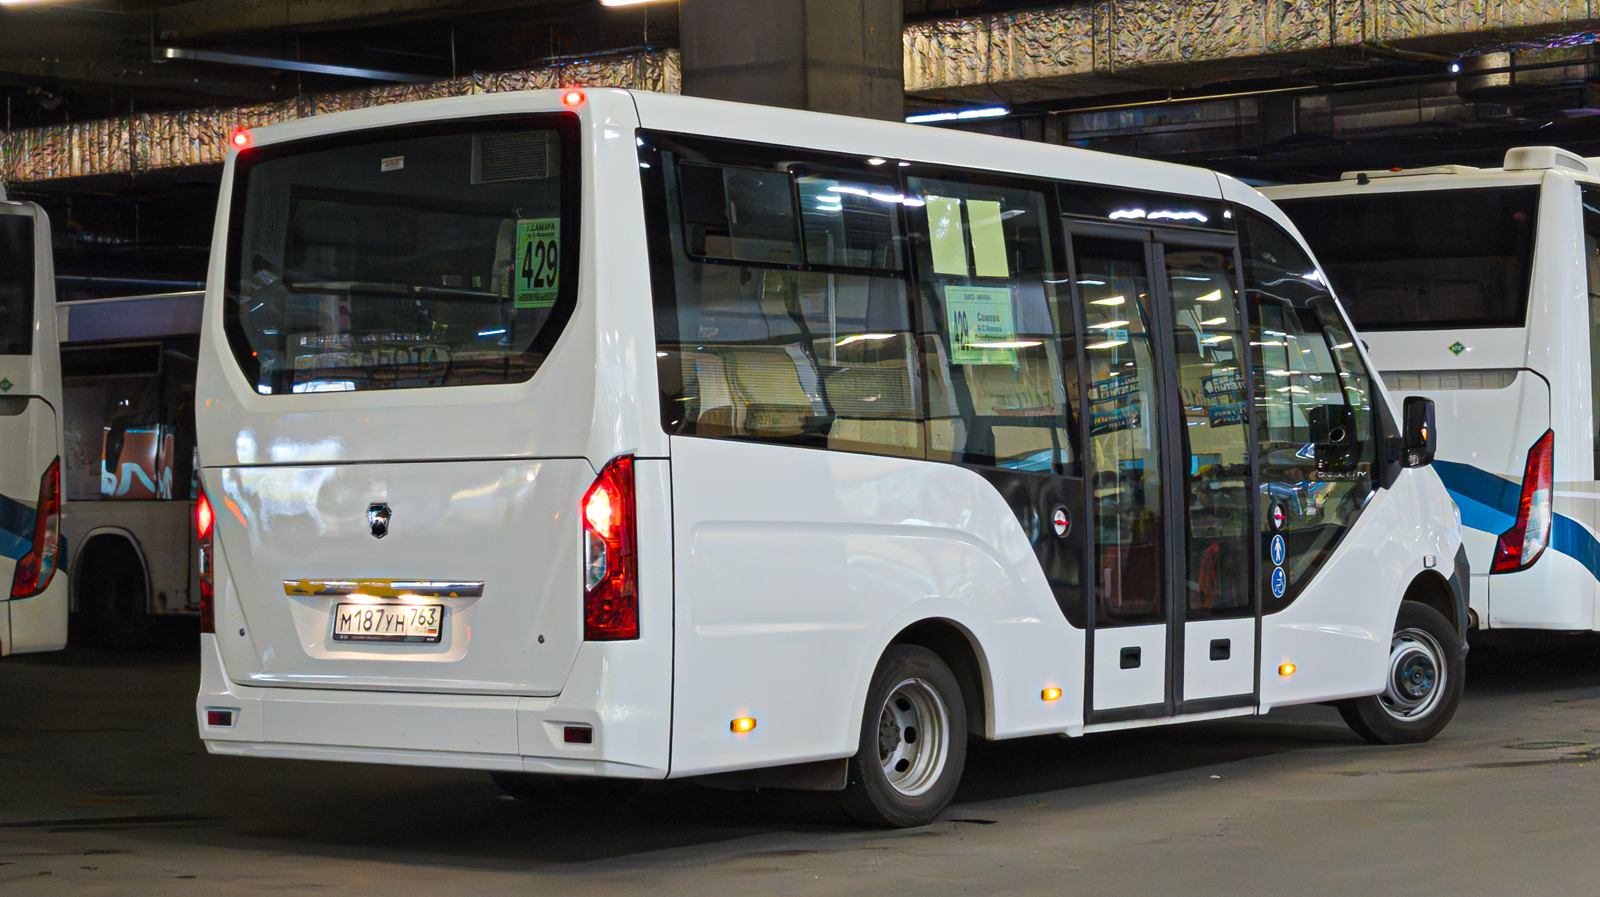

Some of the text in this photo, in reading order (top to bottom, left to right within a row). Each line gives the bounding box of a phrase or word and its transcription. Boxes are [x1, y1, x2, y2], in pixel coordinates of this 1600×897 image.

[521, 240, 558, 288] 429
[340, 608, 436, 632] М187УН 763
